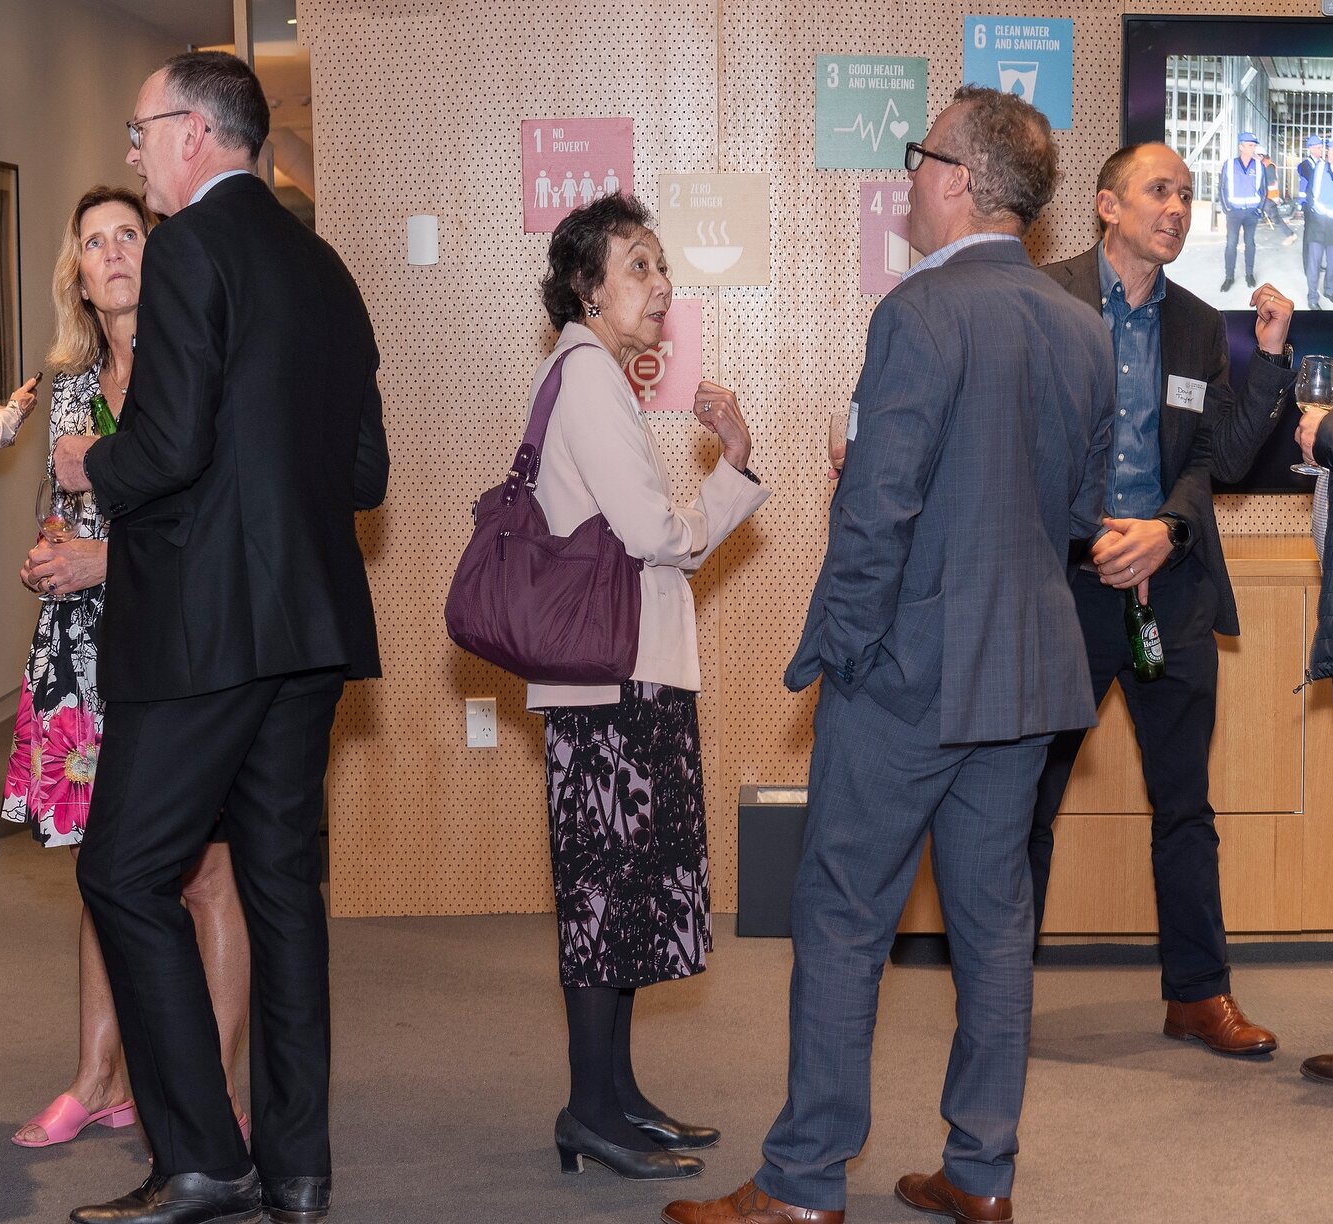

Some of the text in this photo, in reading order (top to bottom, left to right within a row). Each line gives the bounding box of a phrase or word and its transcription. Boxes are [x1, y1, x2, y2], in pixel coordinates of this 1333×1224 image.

[974, 23, 1049, 49] 6 CLEAN WATER
[995, 38, 1060, 51] AND SANITATION
[827, 63, 904, 88] 3 GOOD HEALTH
[848, 77, 915, 90] AND WELL-BEING
[533, 128, 564, 153] 1 NO
[553, 141, 589, 152] POVERTY
[670, 183, 711, 208] 2 ZERO
[690, 197, 723, 208] HUNGER
[870, 190, 883, 215] 4
